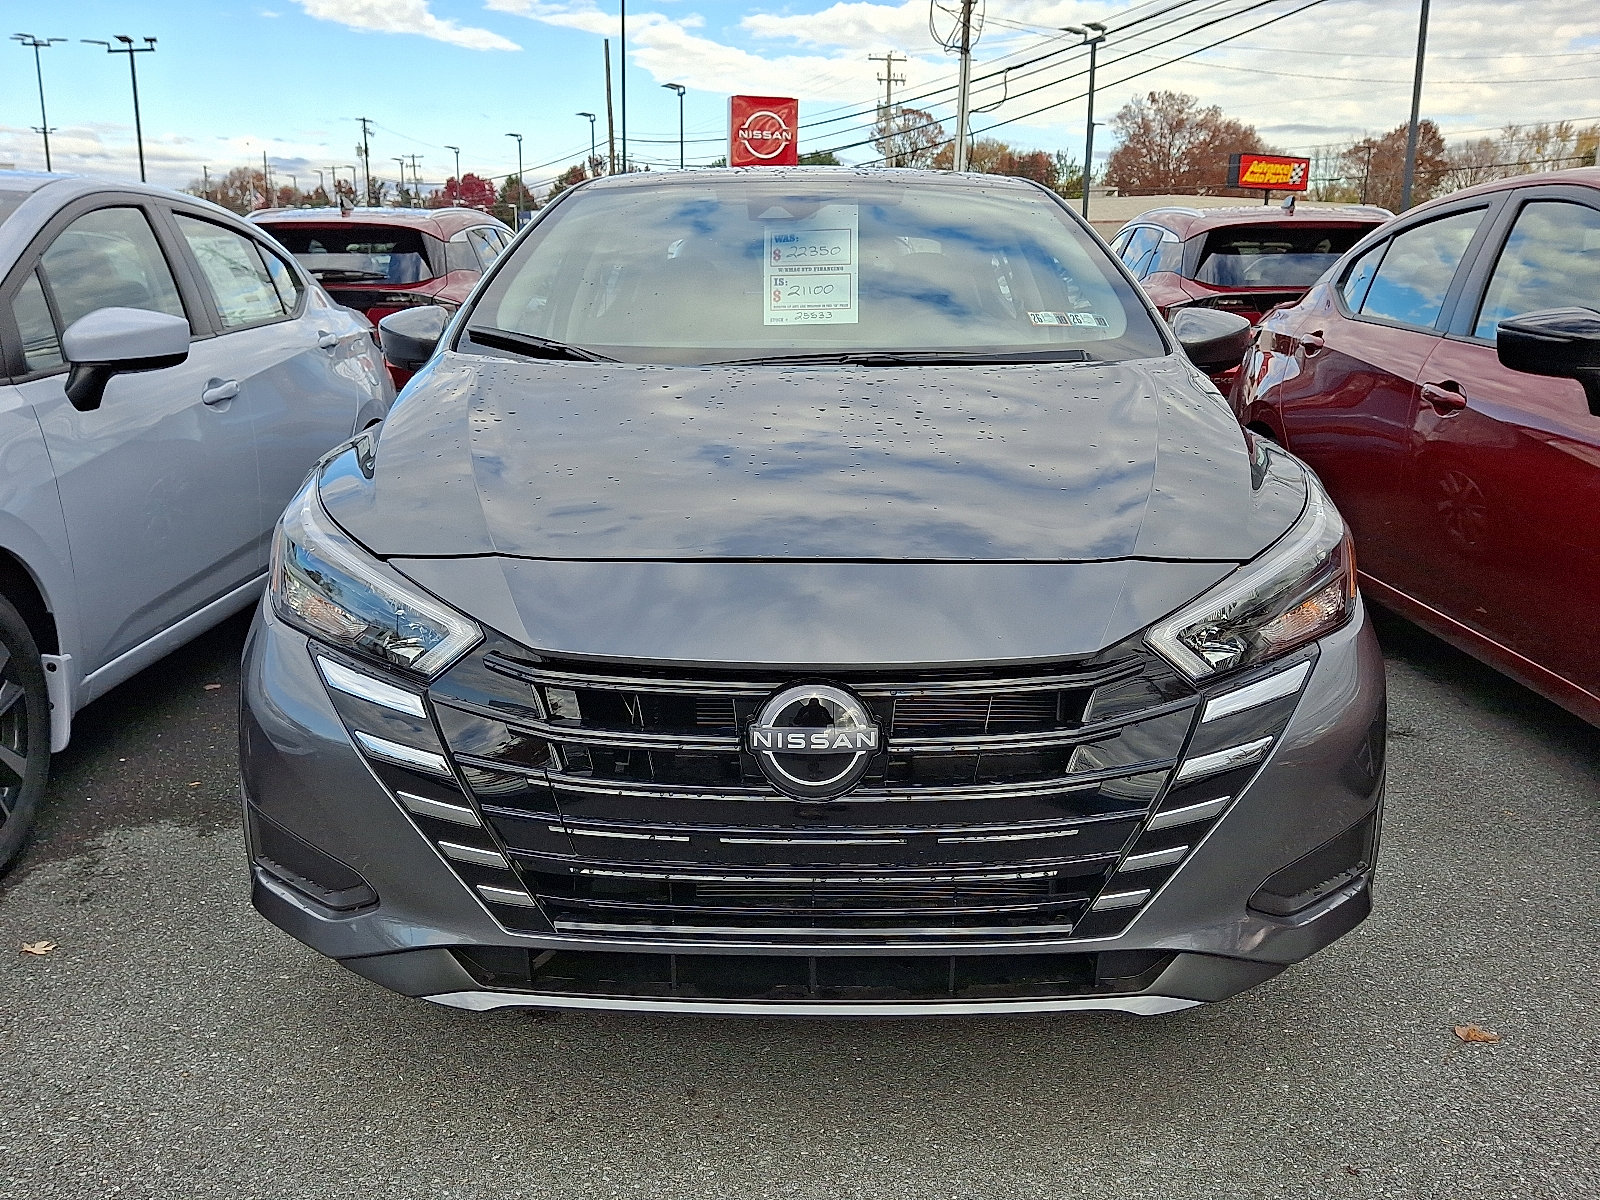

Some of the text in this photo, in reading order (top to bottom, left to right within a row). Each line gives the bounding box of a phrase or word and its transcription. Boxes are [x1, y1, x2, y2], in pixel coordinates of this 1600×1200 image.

[738, 130, 792, 140] NISSAN
[1249, 160, 1290, 174] Advance
[1241, 173, 1289, 184] Auto Parts
[774, 234, 799, 243] WAS:
[786, 245, 842, 259] 22350
[773, 278, 788, 286] IS:
[787, 284, 834, 297] 21100
[1030, 313, 1044, 324] 26
[1070, 314, 1083, 324] 26
[753, 731, 875, 749] NISSAN
